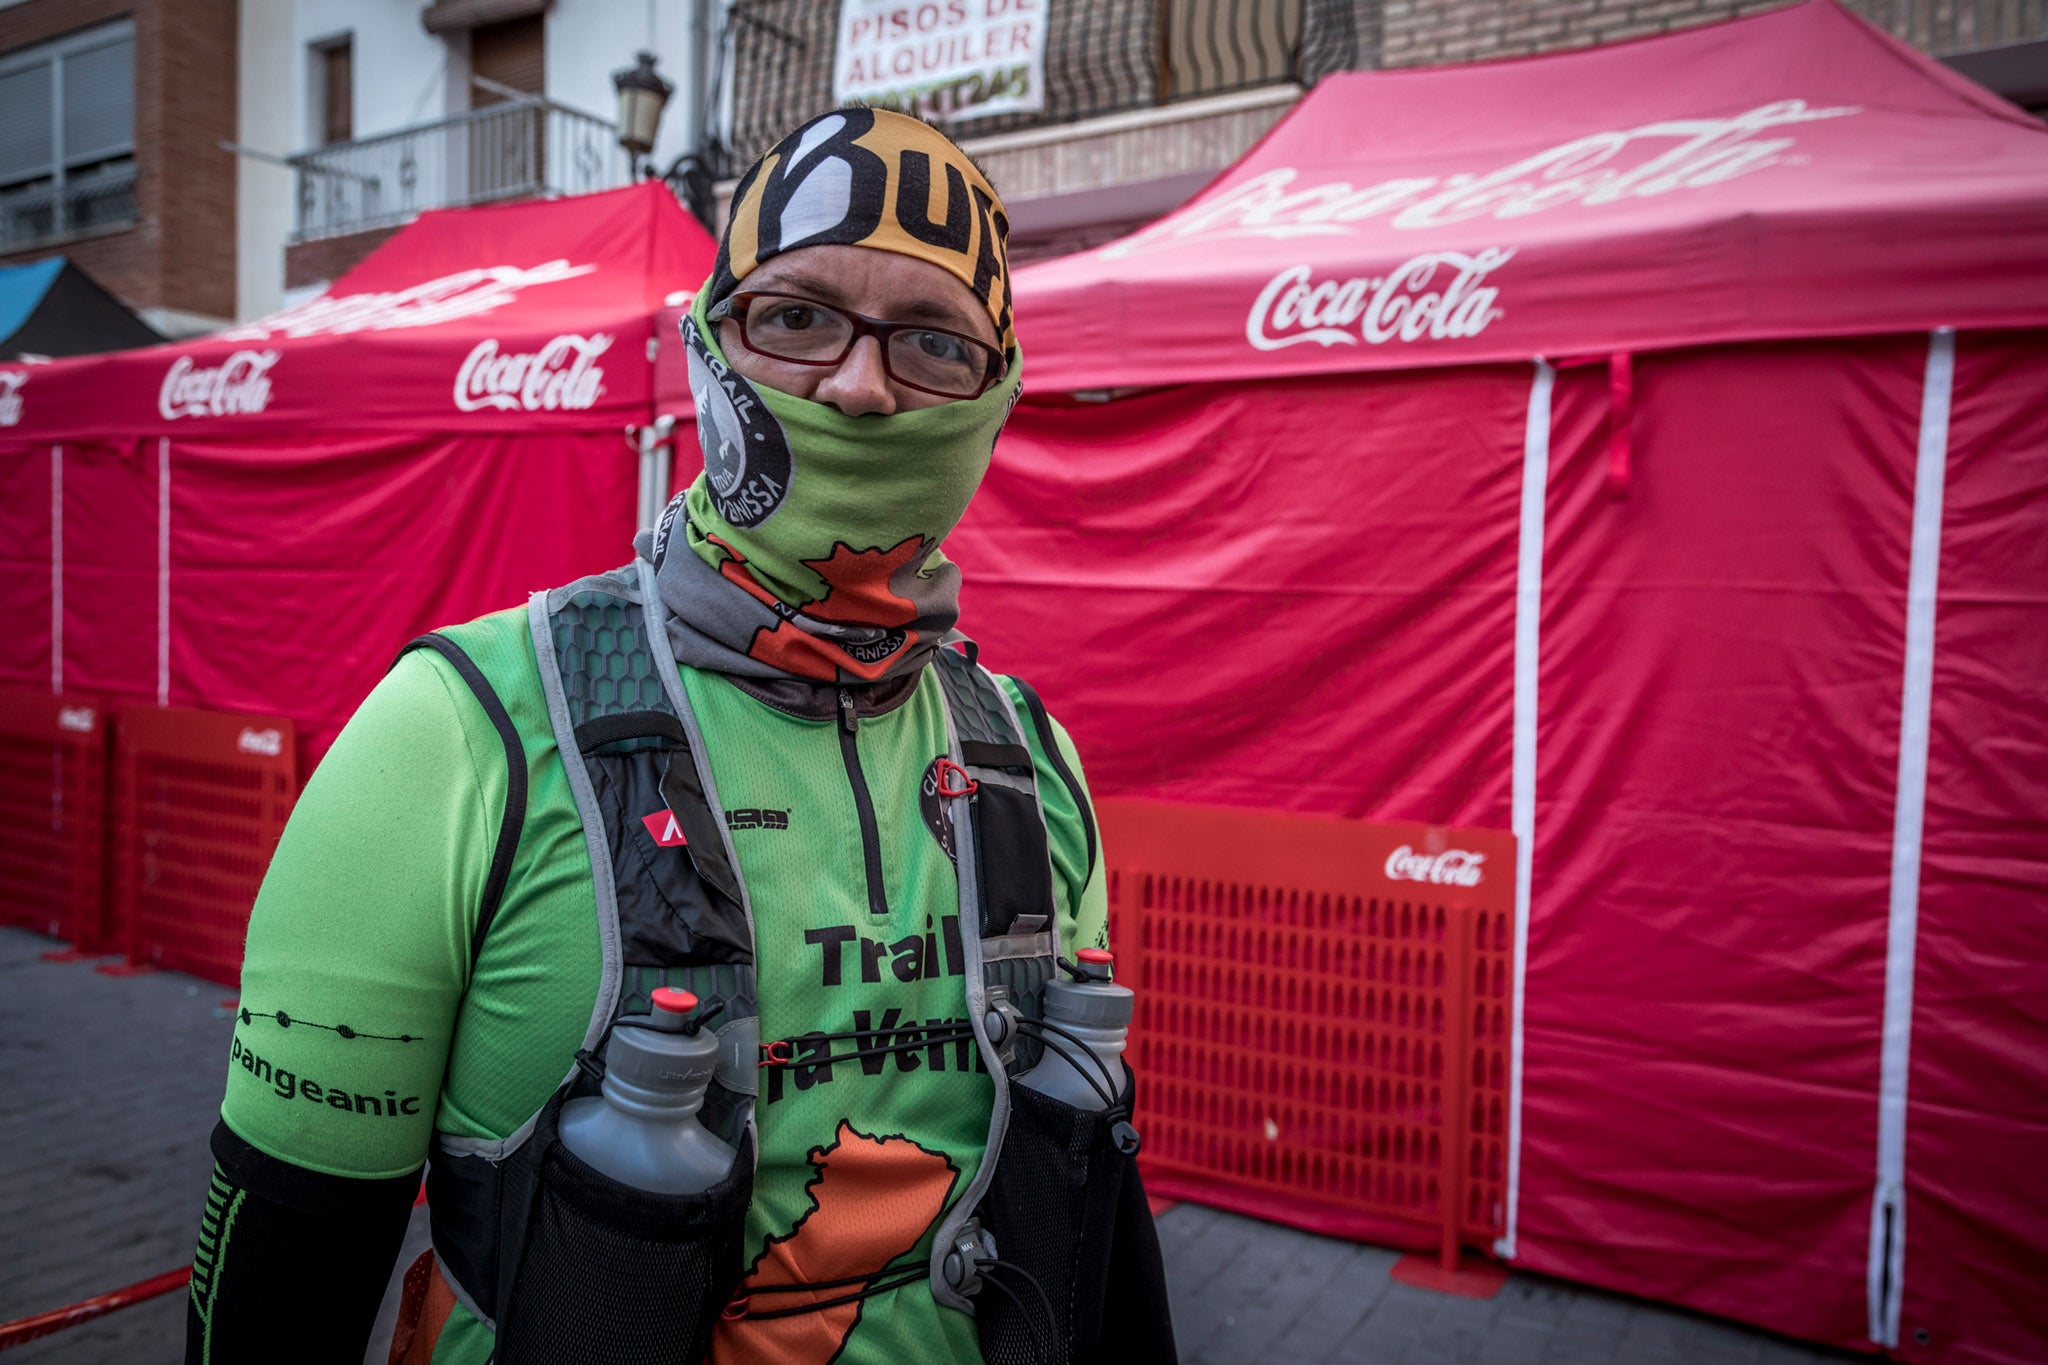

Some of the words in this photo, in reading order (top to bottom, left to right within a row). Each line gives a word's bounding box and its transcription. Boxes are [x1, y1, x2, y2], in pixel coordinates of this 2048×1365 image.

[848, 22, 1032, 87] ALQUILER
[851, 0, 967, 47] PISOS
[804, 912, 966, 987] Trail
[231, 1035, 421, 1117] pangeanic
